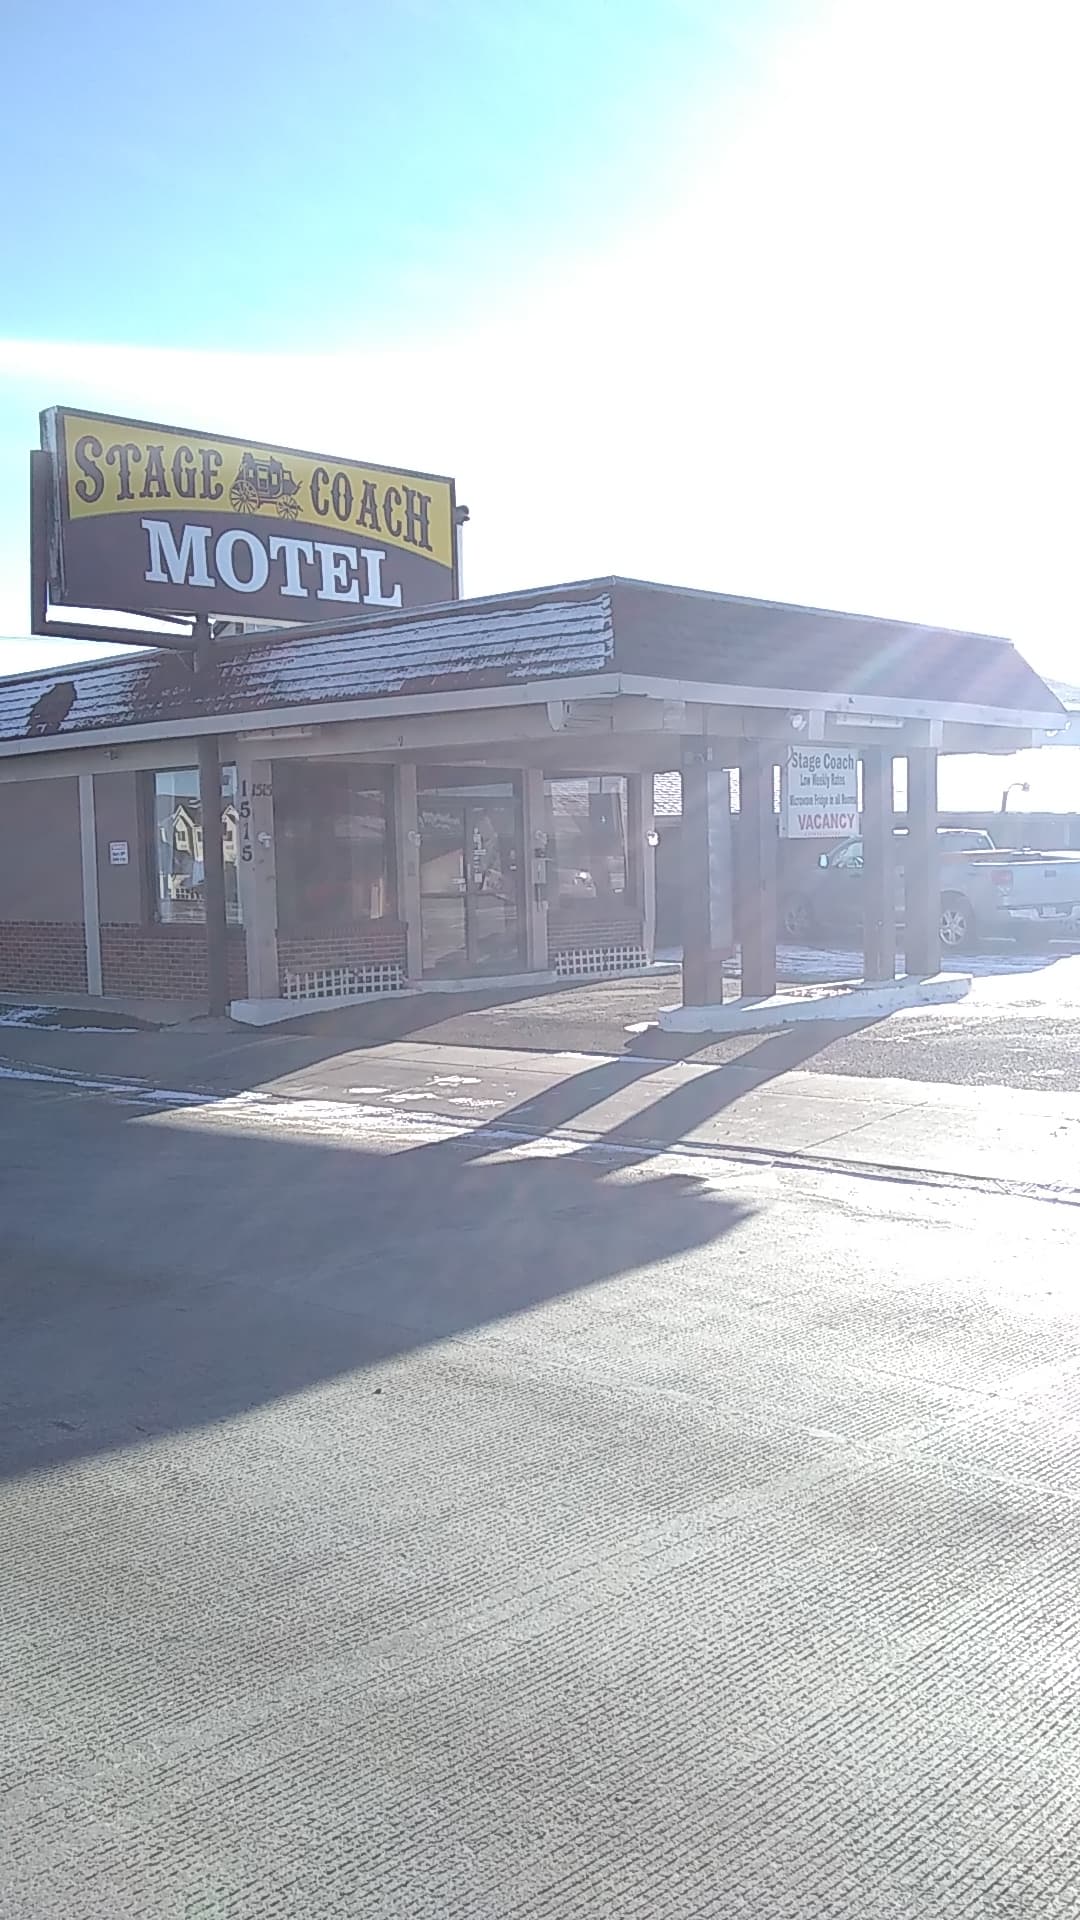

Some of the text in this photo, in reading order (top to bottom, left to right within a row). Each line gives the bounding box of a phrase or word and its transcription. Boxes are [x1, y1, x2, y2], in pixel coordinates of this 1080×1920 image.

[74, 435, 433, 552] STAGE COACH
[141, 518, 403, 607] MOTEL
[791, 751, 854, 772] Stage Coach
[251, 783, 273, 797] 1515
[797, 813, 855, 830] VACANCY
